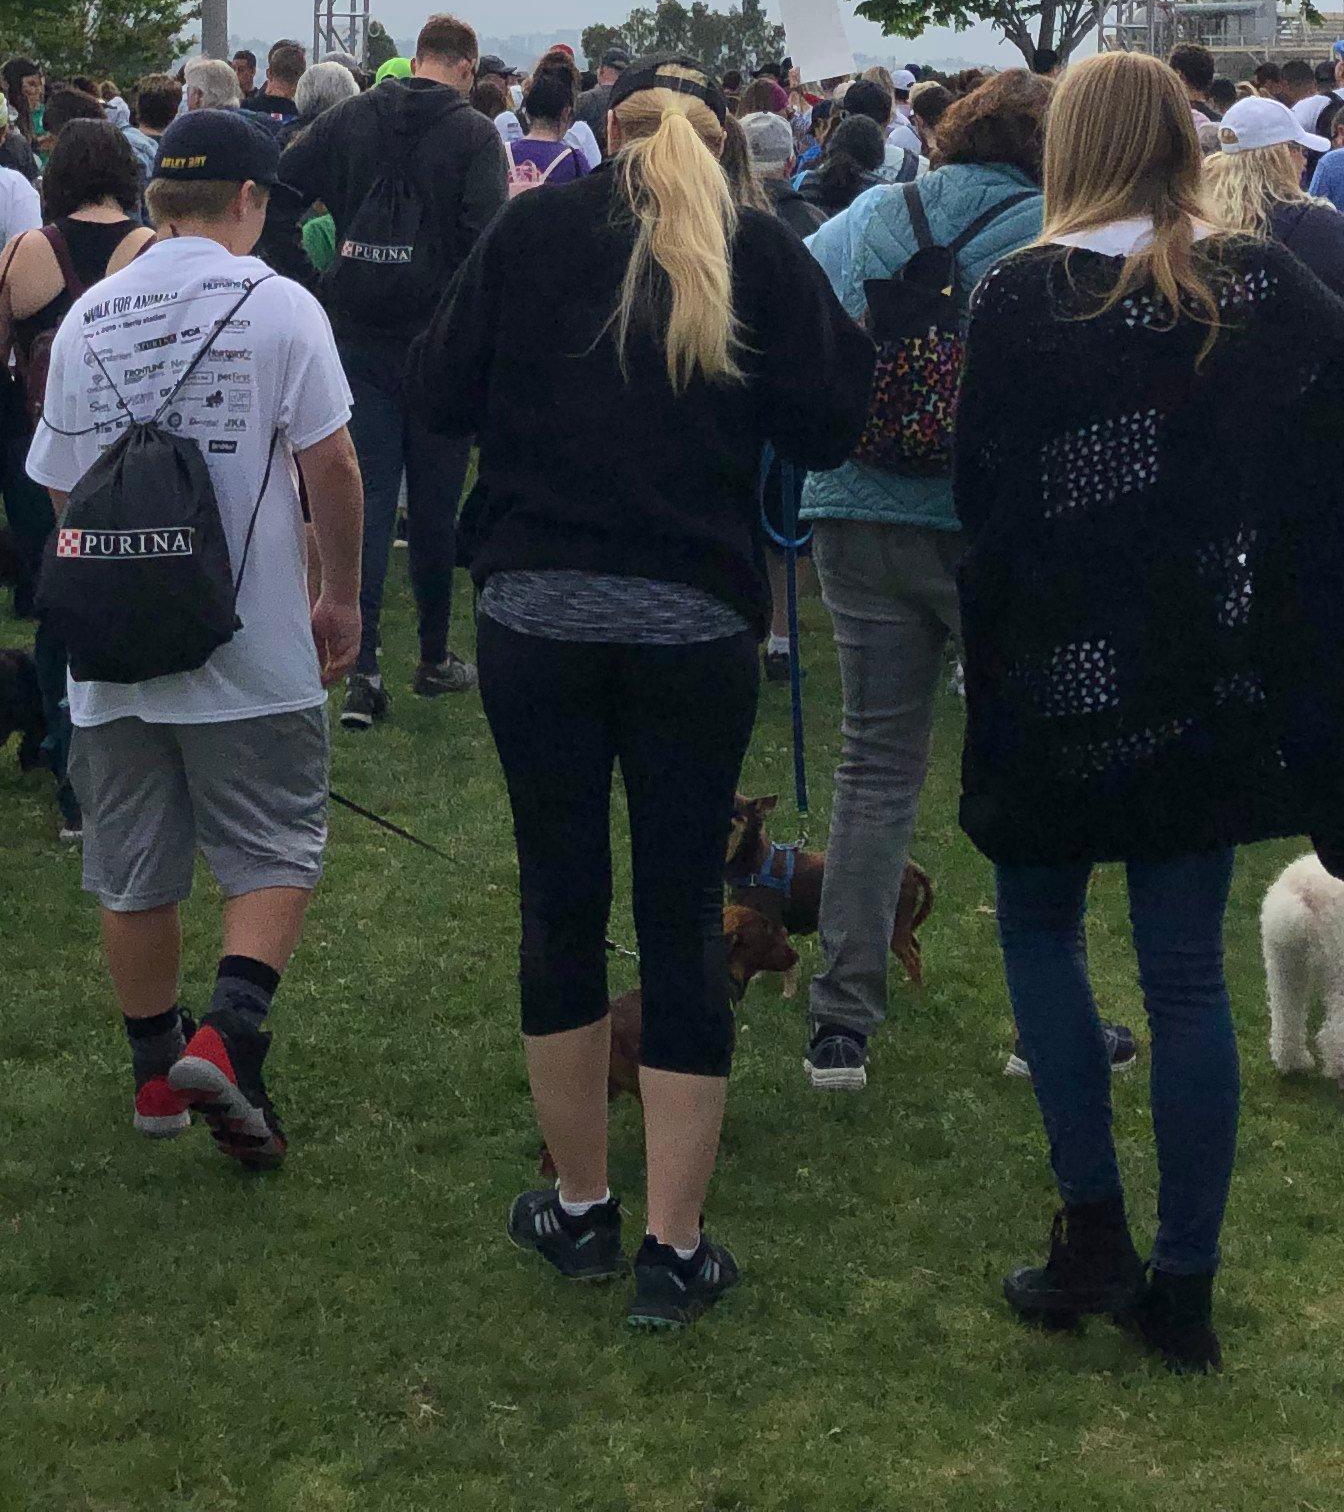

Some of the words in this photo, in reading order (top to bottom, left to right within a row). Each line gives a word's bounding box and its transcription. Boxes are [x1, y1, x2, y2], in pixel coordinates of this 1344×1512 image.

[355, 245, 408, 260] PURINA
[113, 296, 133, 314] FOR
[84, 532, 187, 554] PURINA
